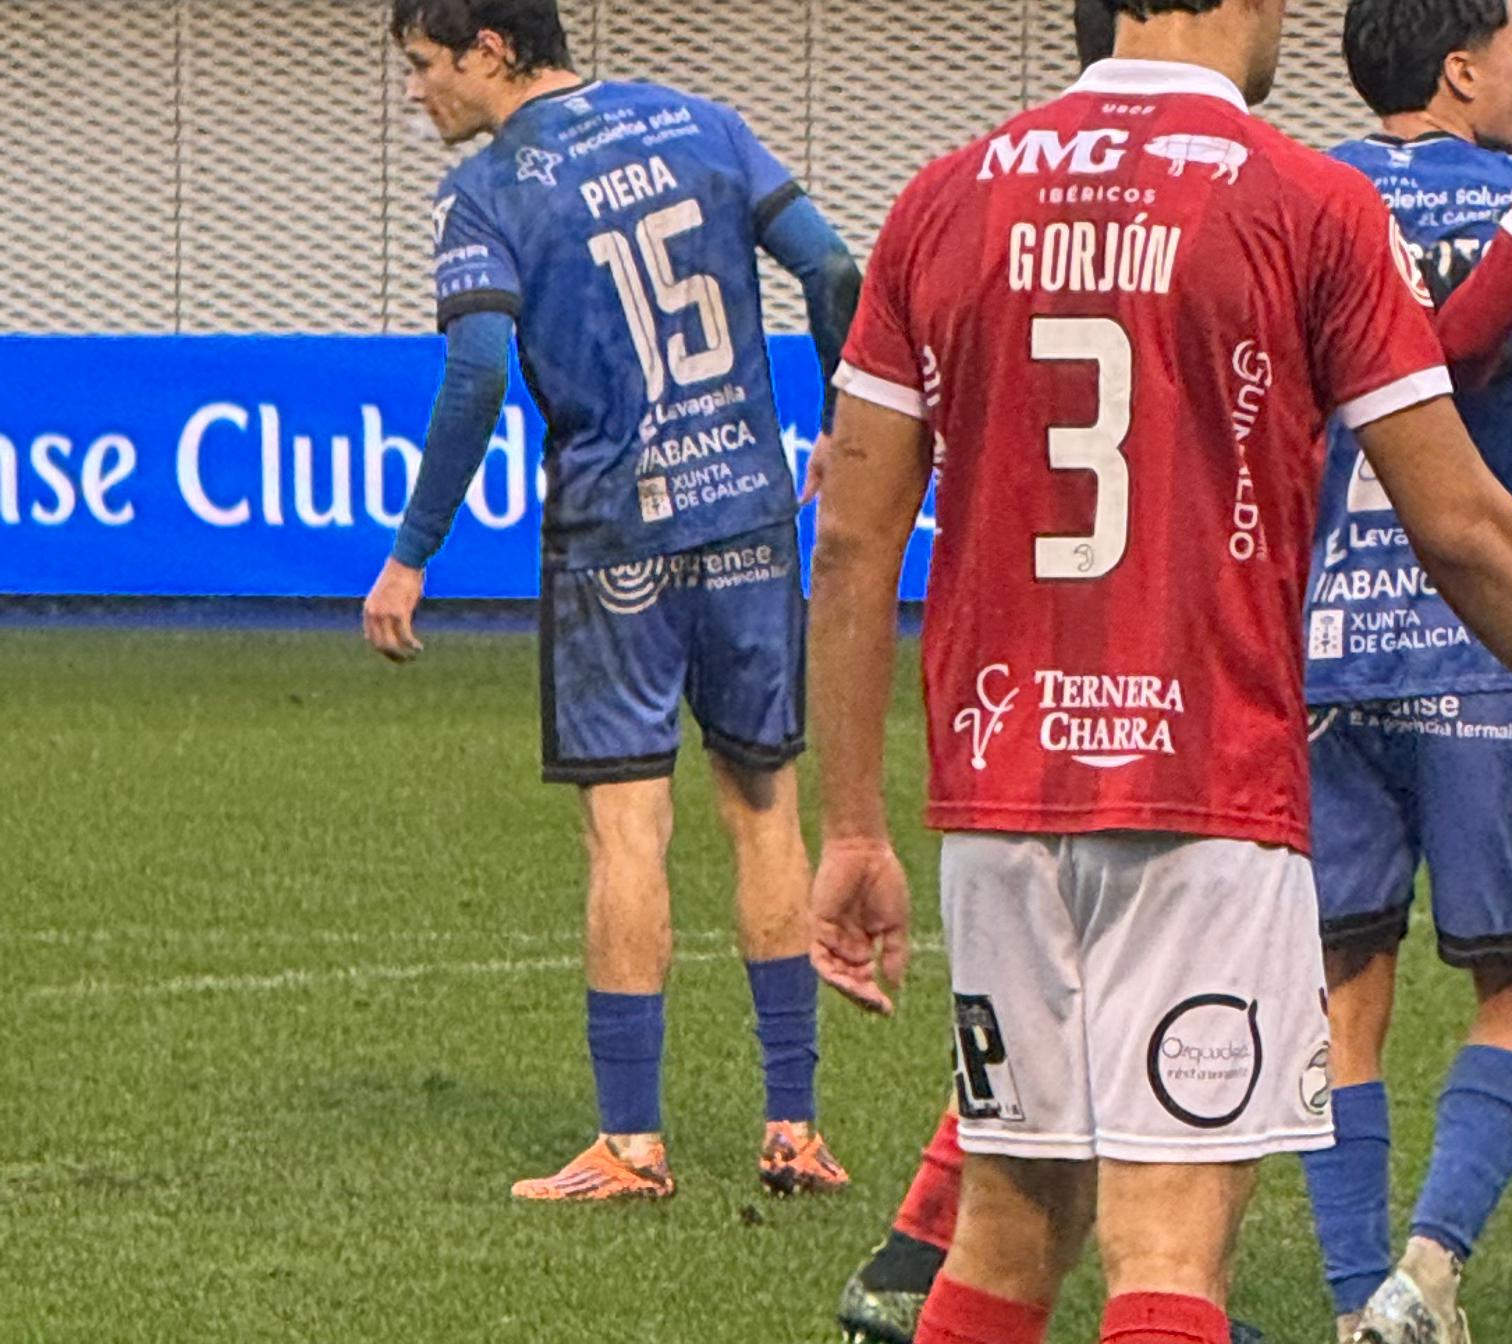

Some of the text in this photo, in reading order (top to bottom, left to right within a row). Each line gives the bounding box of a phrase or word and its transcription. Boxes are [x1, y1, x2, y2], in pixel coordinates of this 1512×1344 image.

[976, 128, 1130, 181] MMG
[579, 156, 678, 219] PIERA
[1038, 184, 1156, 204] IBÉRICOS
[1009, 212, 1181, 294] GORJÓN
[588, 198, 734, 403] 15
[177, 402, 424, 527] Club
[1031, 317, 1131, 580] 3
[671, 462, 732, 491] XUNTA
[674, 471, 769, 511] DE GALICIA
[1350, 625, 1471, 654] DE GALICIA
[1351, 609, 1421, 632] XUNTA
[1034, 669, 1185, 713] TERNERA
[1039, 712, 1176, 755] CHARRA
